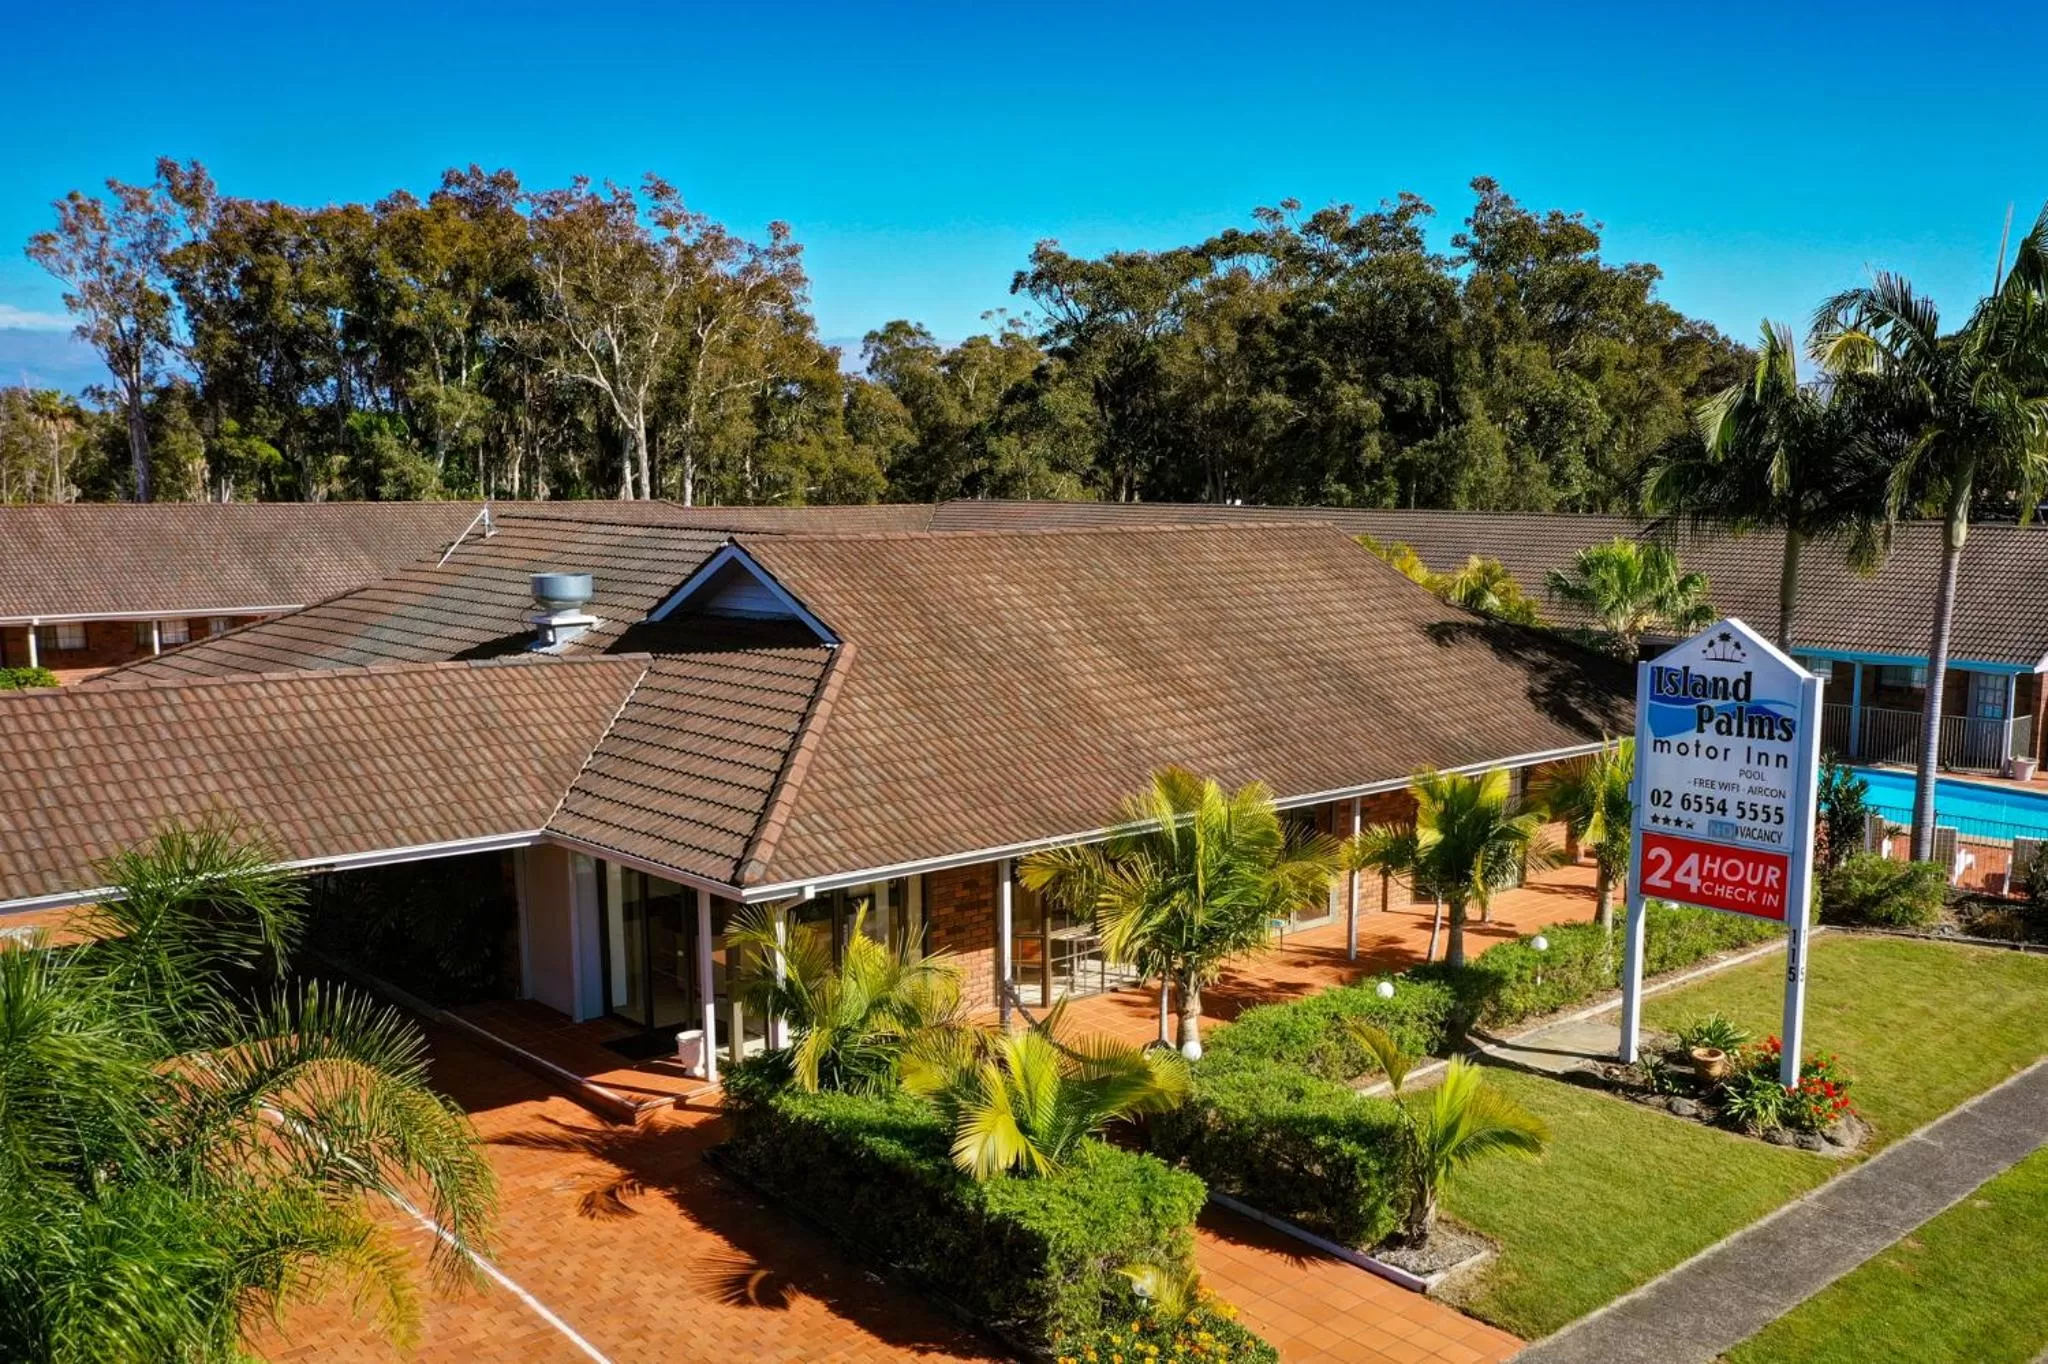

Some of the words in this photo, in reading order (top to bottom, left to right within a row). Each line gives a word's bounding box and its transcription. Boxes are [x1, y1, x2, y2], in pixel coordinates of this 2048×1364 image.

[1655, 666, 1753, 702] Island
[1695, 704, 1794, 743] Palms
[1652, 739, 1731, 761] motor
[1746, 745, 1788, 769] Inn
[1693, 778, 1716, 790] FREE
[1718, 781, 1740, 792] WIFI
[1747, 785, 1786, 799] AIRCON
[1738, 769, 1767, 781] POOL
[1650, 788, 1673, 808] 02
[1680, 793, 1728, 817] 6554
[1736, 800, 1784, 825] 5555
[1739, 825, 1783, 844] VACANCY
[1645, 847, 1701, 893] 24
[1702, 855, 1781, 889] HOUR
[1701, 881, 1757, 904] CHECK
[1761, 892, 1780, 908] IN
